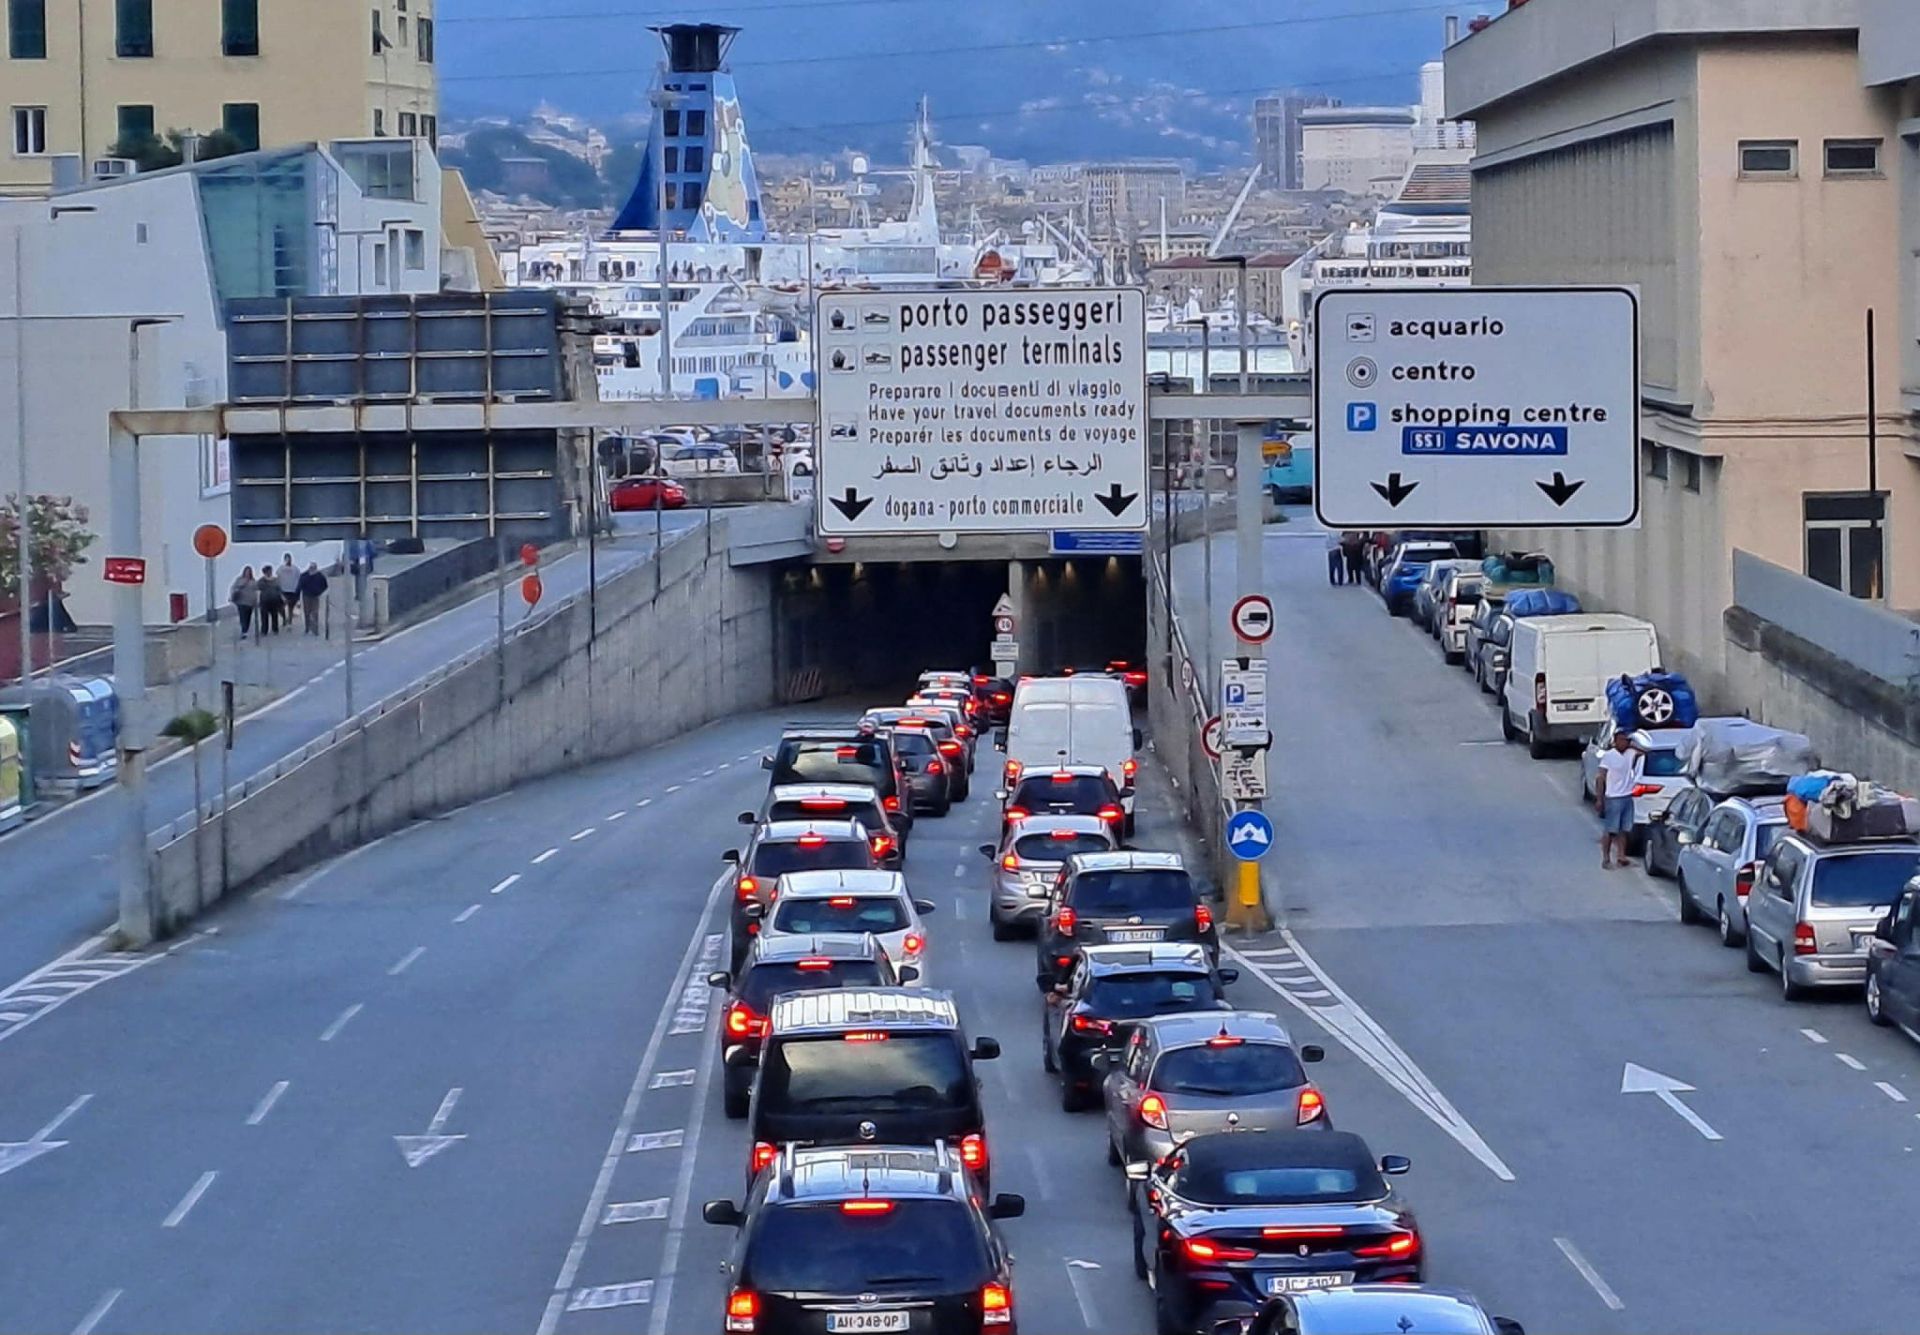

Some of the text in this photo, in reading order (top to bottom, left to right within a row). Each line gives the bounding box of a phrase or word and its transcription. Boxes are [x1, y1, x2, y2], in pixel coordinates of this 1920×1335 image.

[900, 293, 1122, 333] porto passeggeri
[1390, 315, 1504, 340] acquario
[901, 333, 1122, 374] passenger terminals
[1391, 361, 1476, 381] centro
[961, 380, 1039, 398] documenti
[1068, 379, 1122, 400] viaggio
[869, 400, 1136, 425] Have your travel documents ready
[1353, 402, 1607, 428] P shopping centre
[941, 427, 963, 443] les
[970, 425, 1051, 443] documents
[1059, 425, 1076, 441] de
[1084, 427, 1136, 445] voyage
[1414, 432, 1556, 449] SS1 SAVONA
[873, 455, 921, 480] السفر
[989, 455, 1035, 477] إعداد
[1044, 452, 1102, 477] الرجاء
[885, 494, 935, 522] dogana
[949, 494, 986, 522] porto
[992, 491, 1083, 515] commerciale
